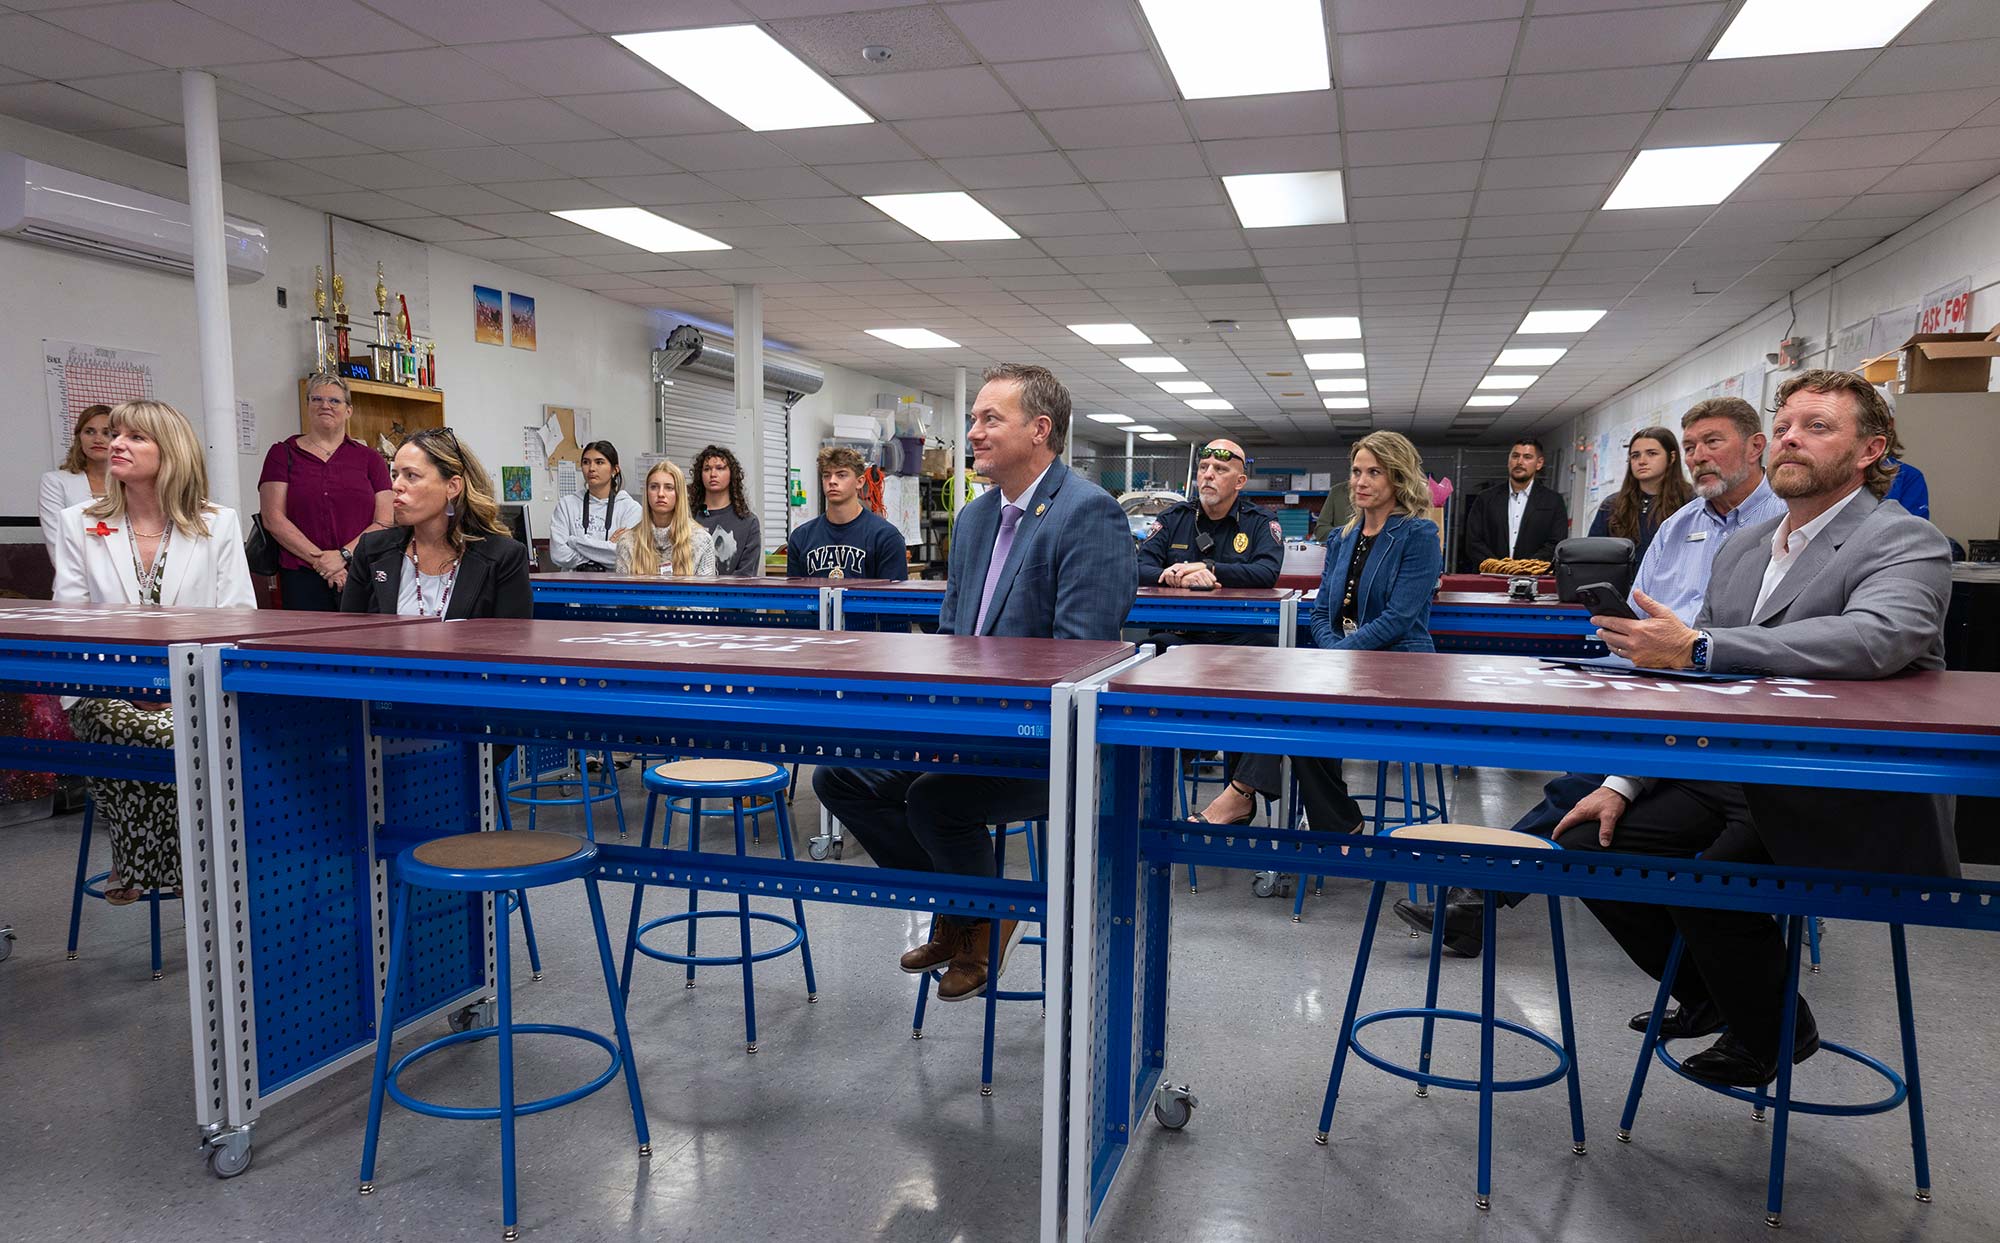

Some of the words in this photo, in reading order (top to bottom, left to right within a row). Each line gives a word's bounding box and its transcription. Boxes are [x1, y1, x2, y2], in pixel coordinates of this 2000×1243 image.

[1921, 306, 1942, 333] ASK
[1944, 293, 1969, 327] FOR
[807, 545, 866, 575] NAVY
[558, 637, 803, 652] TANGO
[601, 631, 860, 645] FLIGHT
[1467, 675, 1837, 699] TANGO
